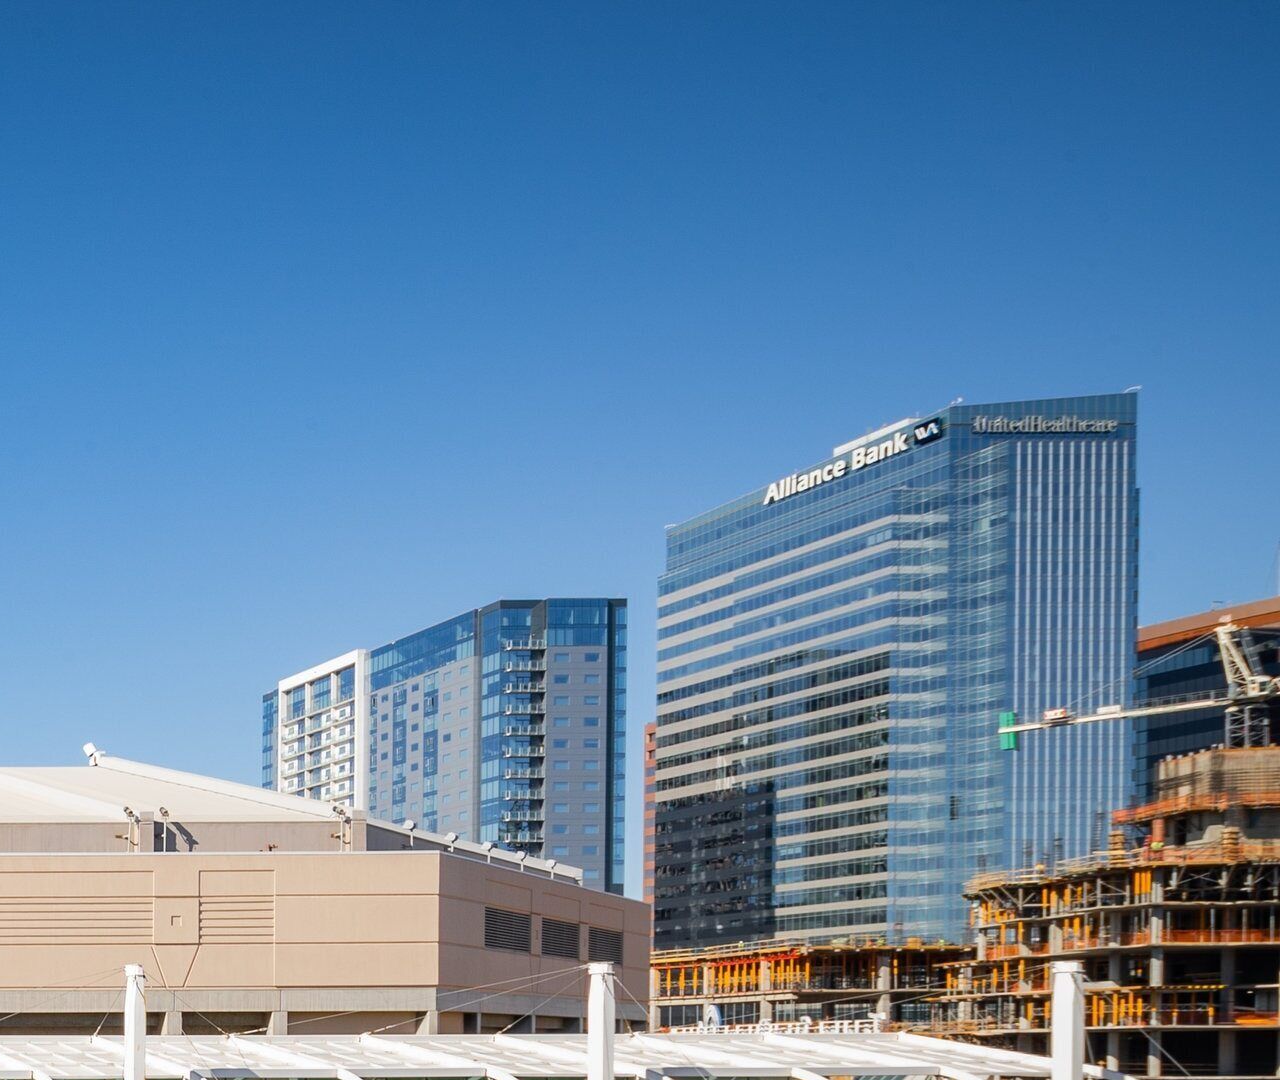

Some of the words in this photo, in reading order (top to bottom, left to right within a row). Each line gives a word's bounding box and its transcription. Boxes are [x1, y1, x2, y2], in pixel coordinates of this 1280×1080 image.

[973, 415, 1118, 433] UnitedHealthcare
[763, 459, 846, 505] Alliance
[851, 431, 908, 471] Bank
